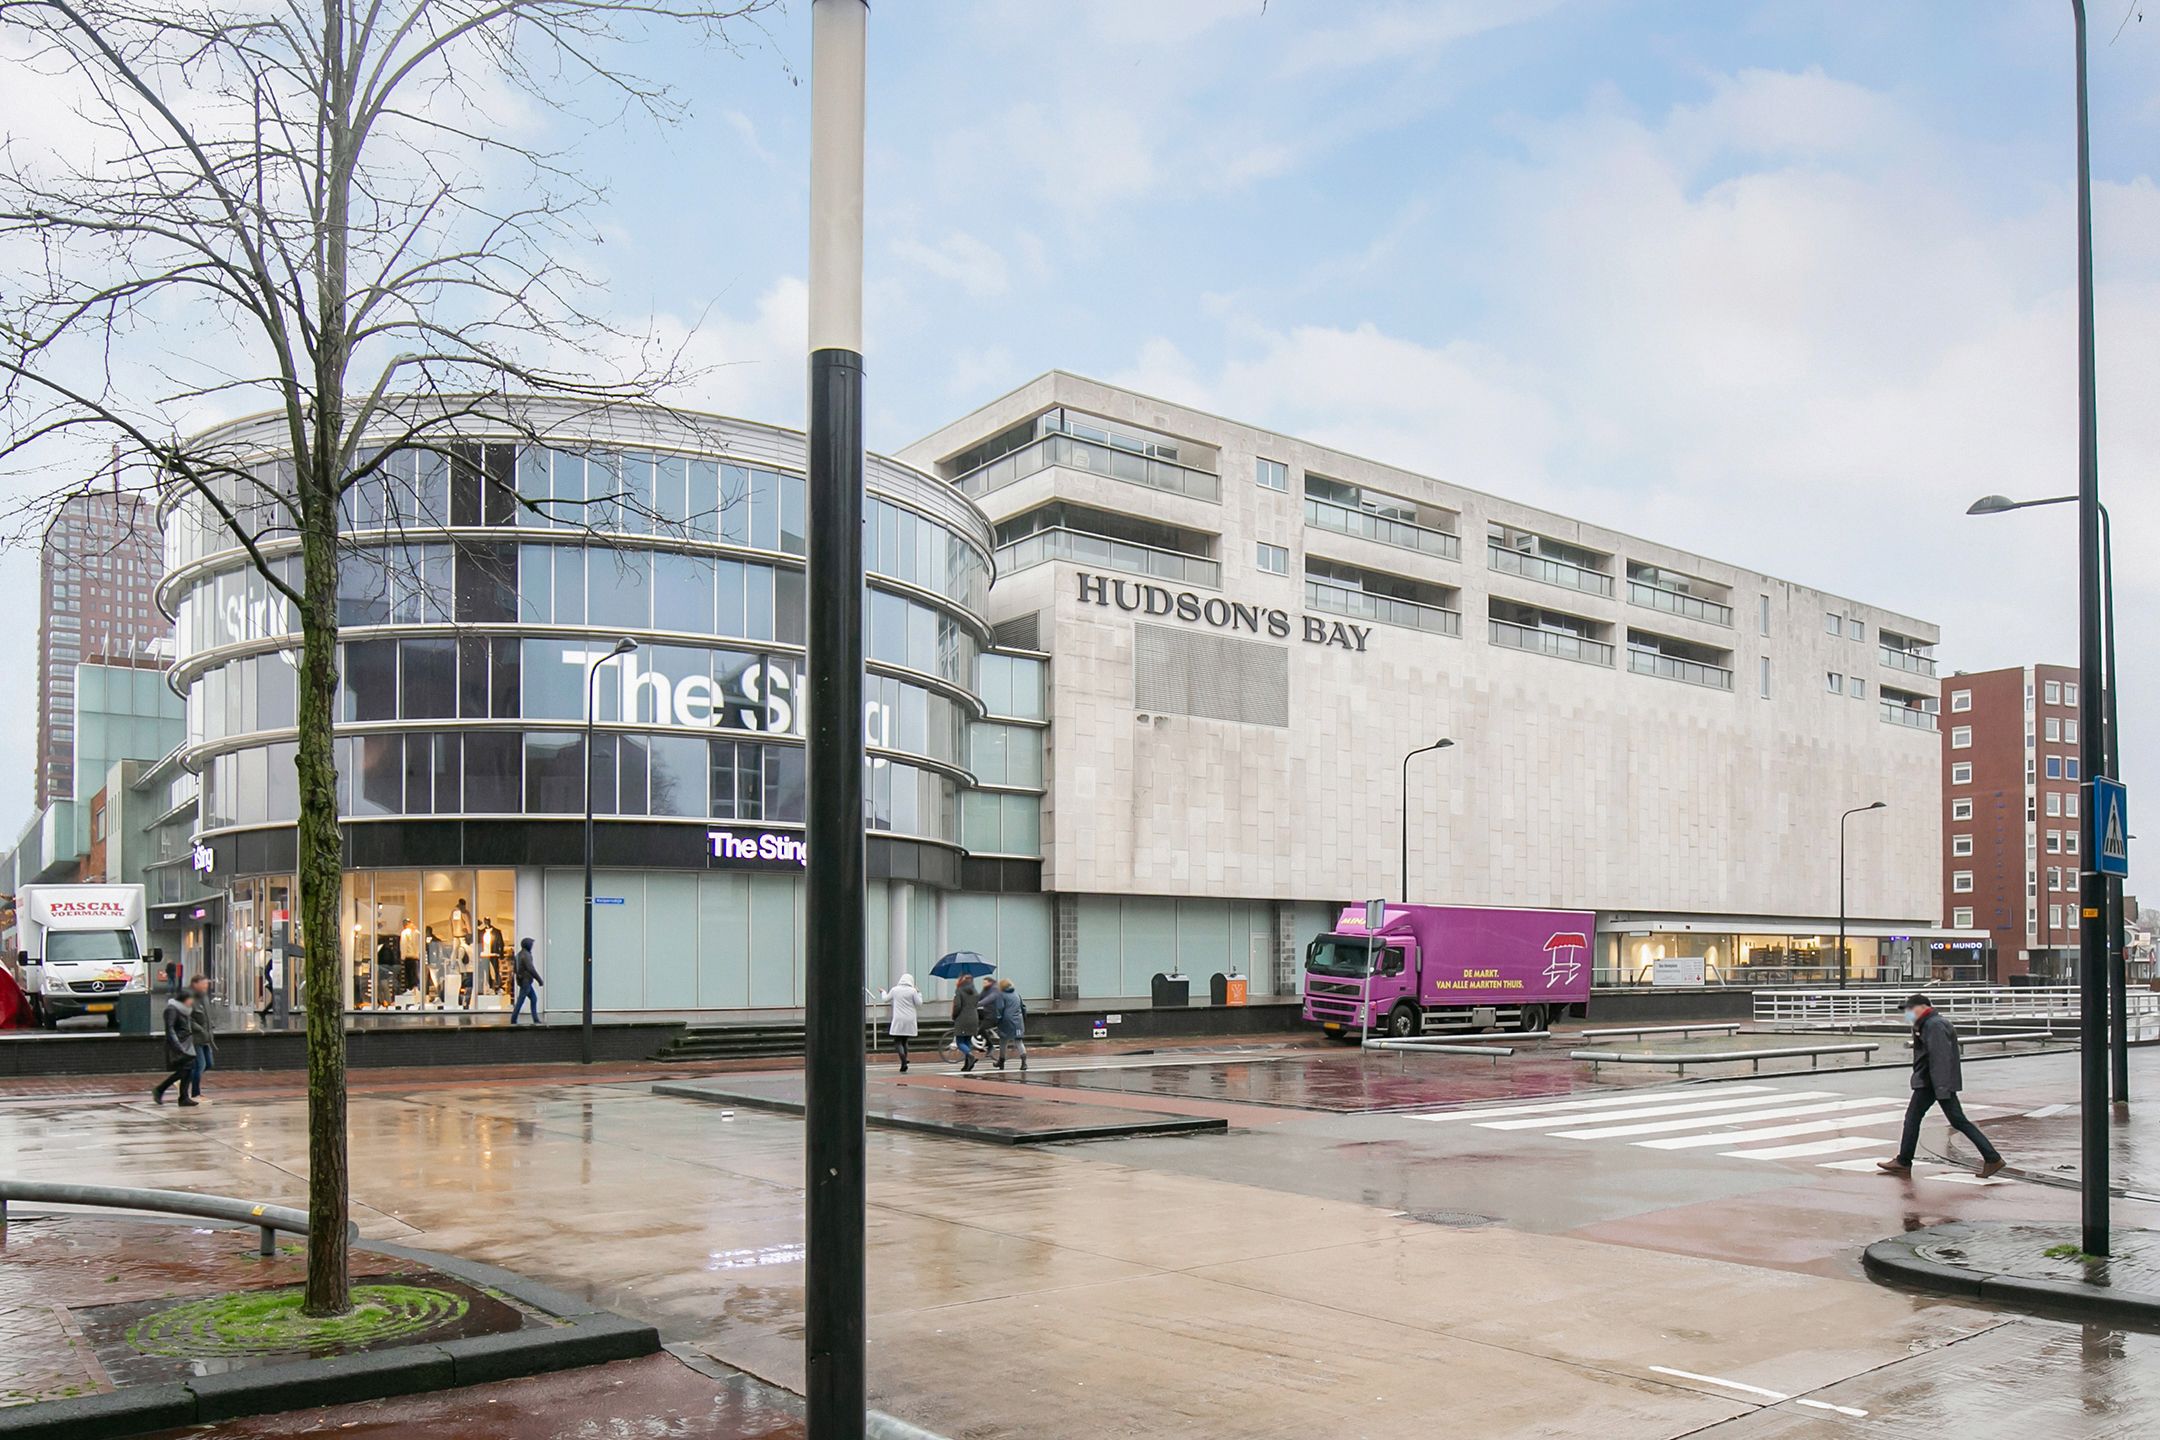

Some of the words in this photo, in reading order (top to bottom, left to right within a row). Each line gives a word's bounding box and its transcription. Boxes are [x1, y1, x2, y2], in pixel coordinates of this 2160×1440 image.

[1076, 572, 1291, 638] HUDSON'S
[1301, 614, 1373, 652] BAY
[562, 649, 724, 728] The
[706, 831, 758, 860] The
[50, 902, 125, 911] PASCAL
[1463, 969, 1473, 978] DE
[1436, 980, 1452, 989] VAN
[1452, 980, 1469, 989] ALLE
[1469, 980, 1502, 989] MARKTEN
